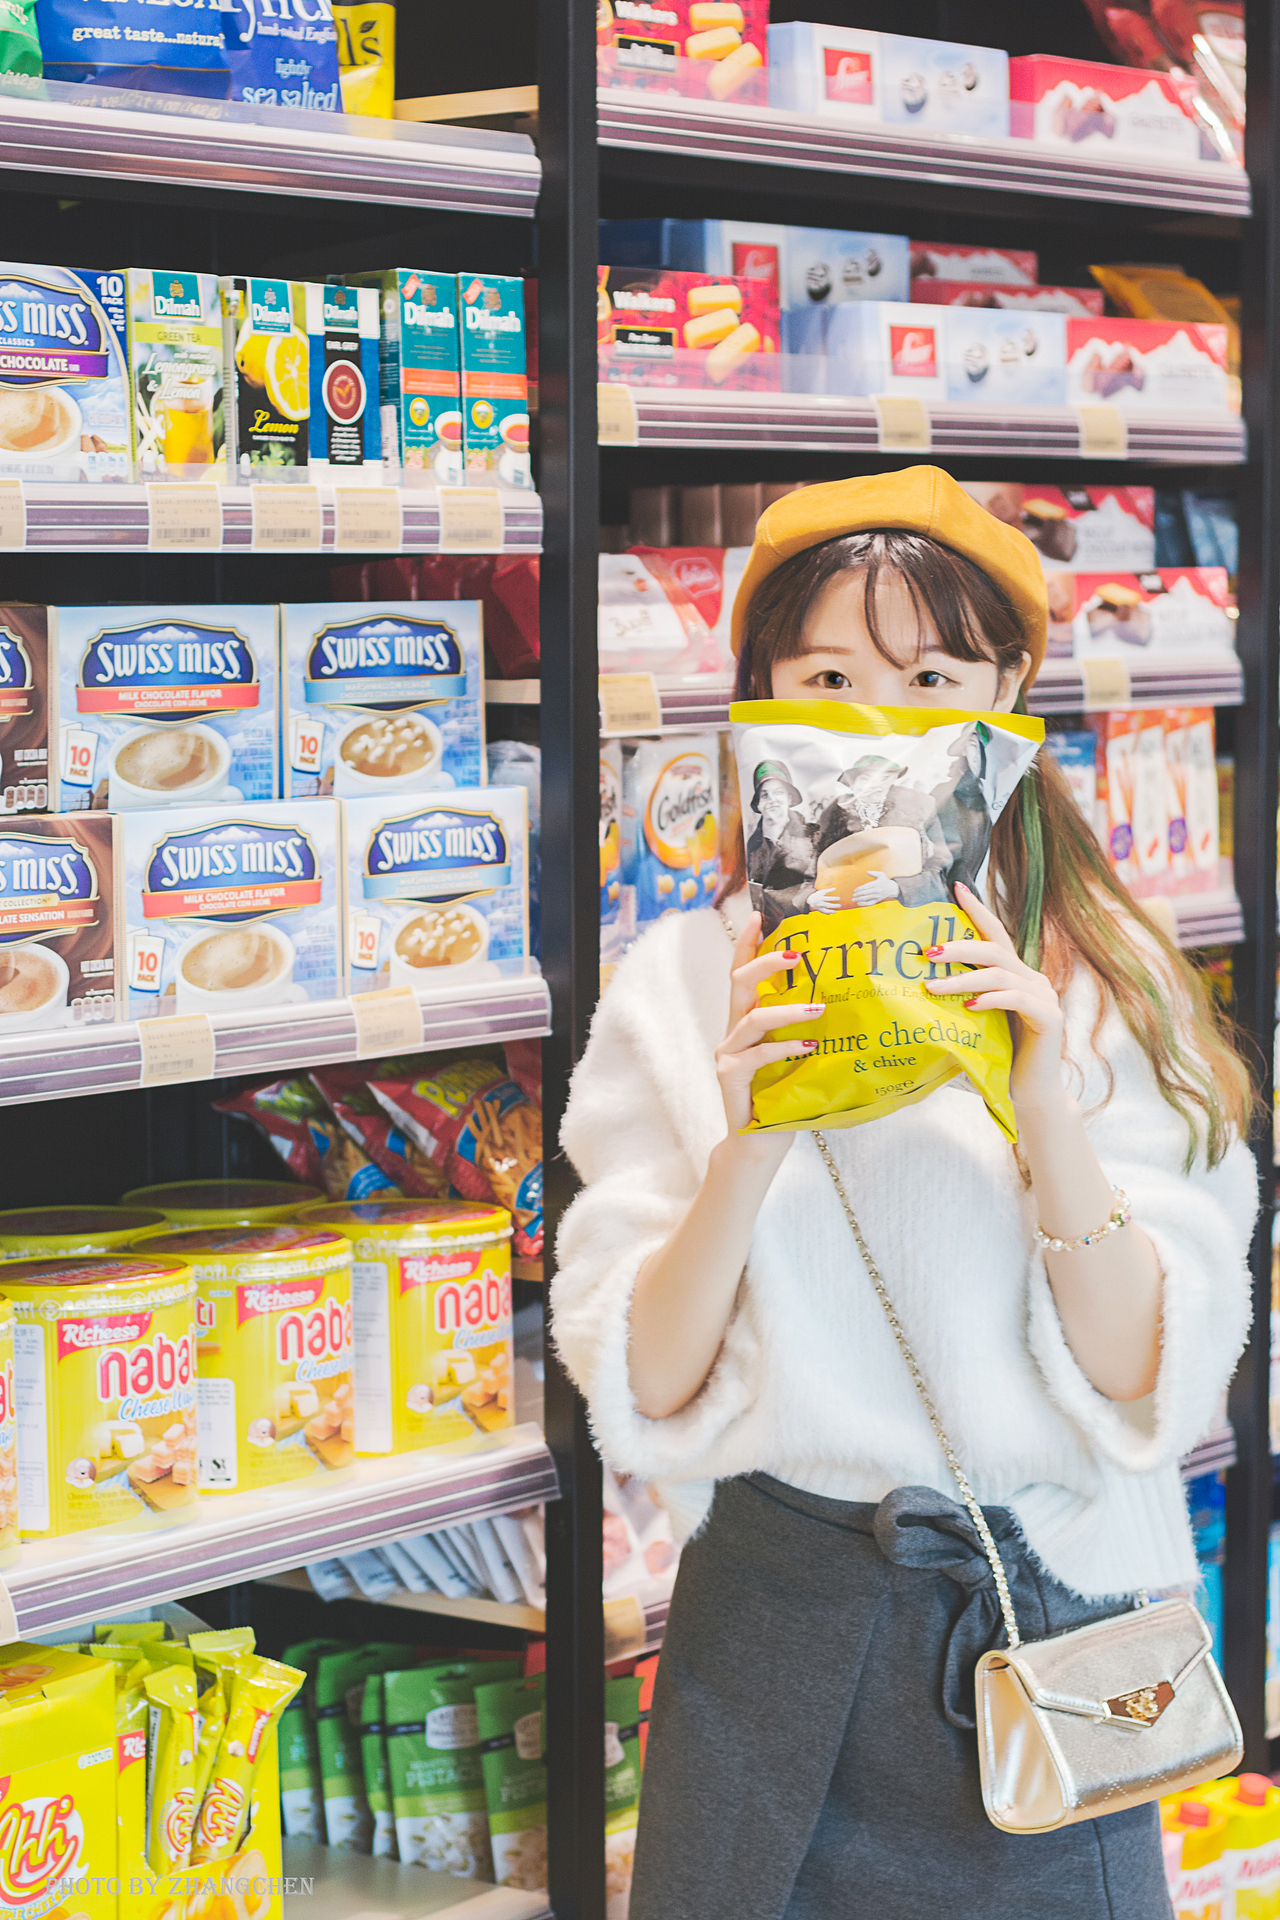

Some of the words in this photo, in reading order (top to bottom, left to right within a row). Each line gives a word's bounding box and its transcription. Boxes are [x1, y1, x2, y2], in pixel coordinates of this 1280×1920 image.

[72, 26, 121, 41] great
[242, 86, 277, 106] sea
[281, 81, 338, 111] salted
[97, 276, 123, 297] 10
[101, 297, 124, 305] PACK
[154, 296, 201, 317] Dilmah
[22, 301, 88, 345] MISS
[404, 302, 454, 328] Dilmah
[466, 306, 521, 332] Dilmah
[157, 331, 184, 342] GREEN
[186, 332, 201, 343] TEA
[1, 355, 69, 372] CHOCOLATE
[142, 352, 218, 380] Lemongrass
[160, 376, 202, 400] Lemon
[248, 409, 299, 435] Lemon
[95, 642, 174, 683] SWISS
[178, 640, 241, 680] MISS
[320, 635, 391, 675] SWISS
[394, 632, 450, 672] MISS
[118, 690, 139, 701] MILK
[140, 689, 190, 701] CHOCOLATE
[191, 688, 222, 699] FLAVOR
[133, 700, 172, 708] CHOCOLATE
[300, 734, 319, 755] 10
[71, 746, 91, 767] 10
[69, 767, 88, 777] PACK
[377, 830, 442, 871] SWISS
[445, 823, 498, 862] MISS
[161, 844, 237, 887] SWISS
[242, 837, 304, 878] MISS
[12, 853, 78, 895] MISS
[4, 897, 48, 908] COLLECTION
[184, 894, 204, 905] MILK
[206, 889, 254, 903] CHOCOLATE
[255, 887, 285, 900] FLAVOR
[199, 901, 236, 911] CHOCOLATE
[19, 910, 65, 923] SENSATION
[359, 931, 376, 950] 10
[138, 951, 158, 972] 10
[137, 973, 156, 983] PACK
[821, 986, 898, 1005] hand-cooked
[878, 1019, 982, 1049] cheddar
[853, 1058, 870, 1074] &
[873, 1054, 917, 1069] chive
[244, 1288, 315, 1313] Richeese
[62, 1322, 141, 1350] Richeese
[296, 1357, 343, 1382] Cheese
[120, 1395, 173, 1421] Cheese
